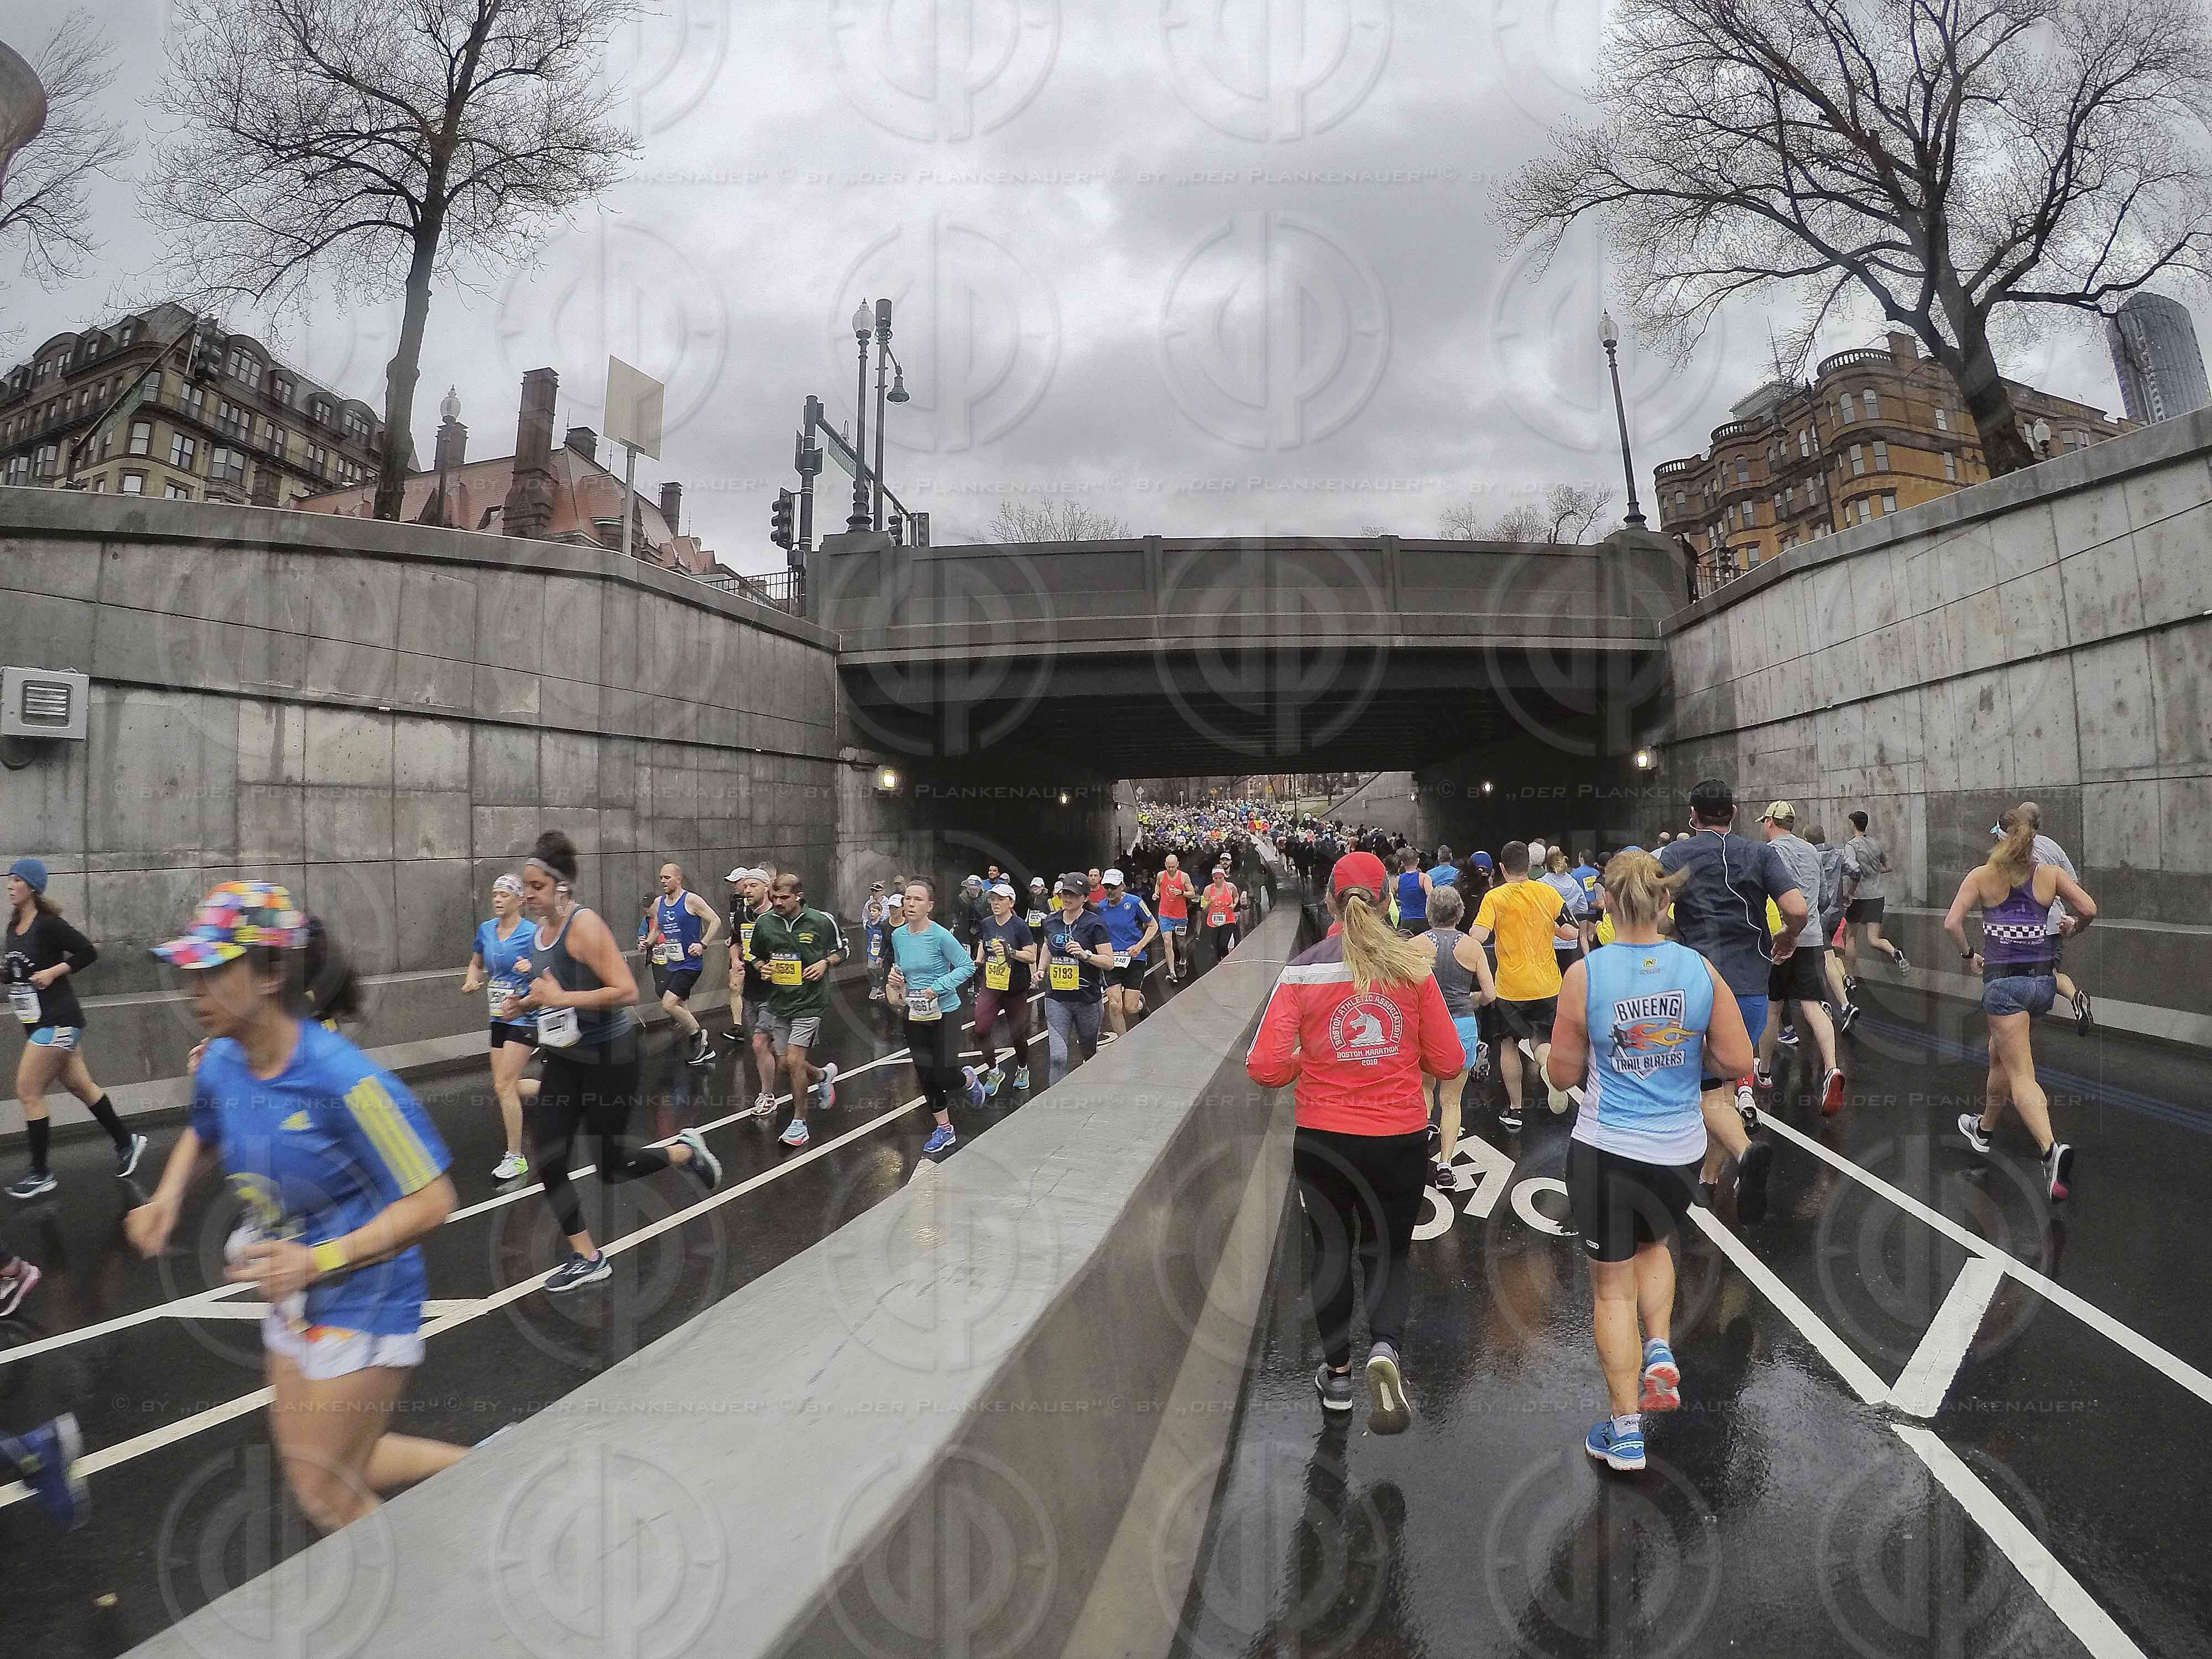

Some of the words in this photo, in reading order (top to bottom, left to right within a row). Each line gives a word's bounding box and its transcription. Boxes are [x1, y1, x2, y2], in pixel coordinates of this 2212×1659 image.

[1053, 967, 1073, 979] 5193
[1616, 997, 1679, 1022] BWEENG
[1332, 1016, 1343, 1046] BOSTON
[1375, 995, 1401, 1041] ASSOCIATION
[1365, 1046, 1399, 1057] MARATHON
[1615, 1056, 1641, 1072] TRAIL
[1644, 1051, 1683, 1069] BLAZERS
